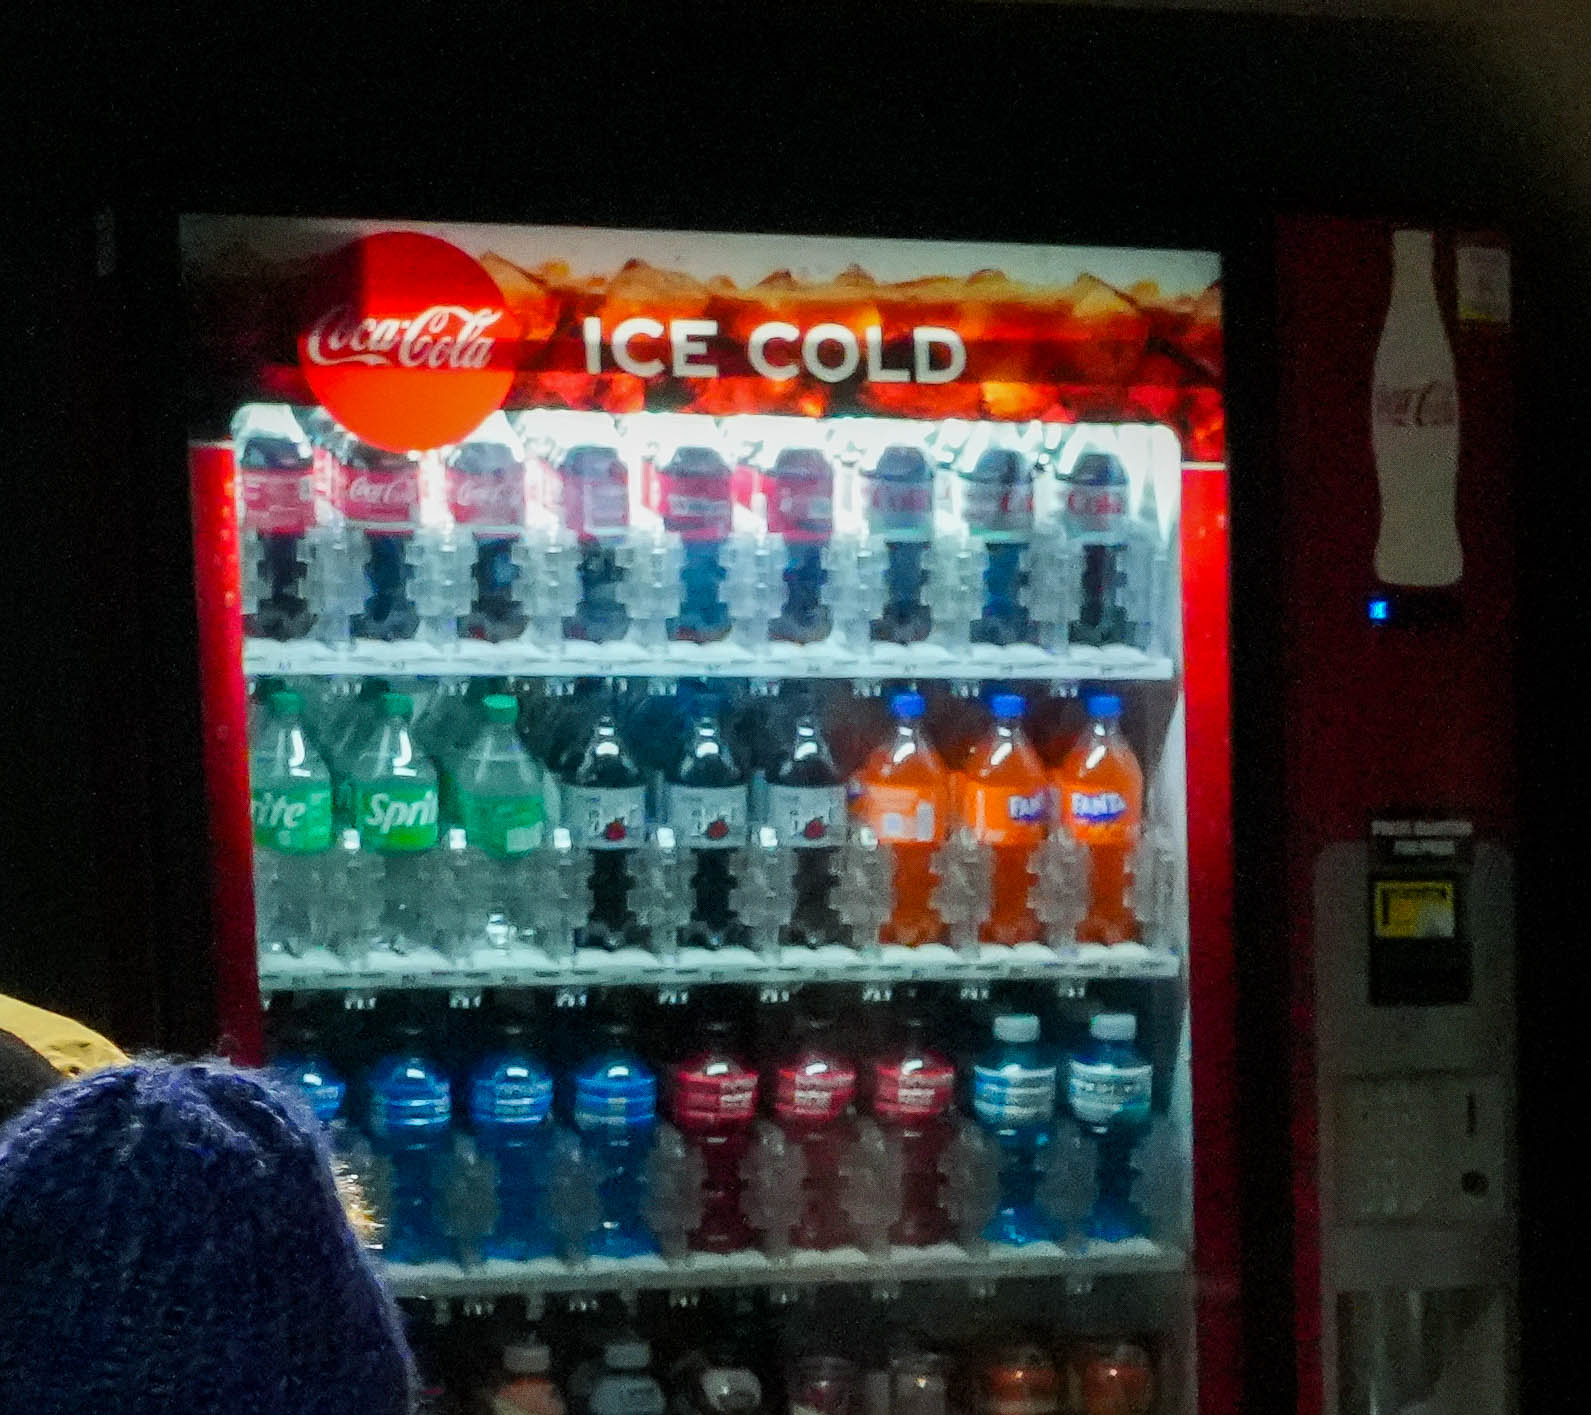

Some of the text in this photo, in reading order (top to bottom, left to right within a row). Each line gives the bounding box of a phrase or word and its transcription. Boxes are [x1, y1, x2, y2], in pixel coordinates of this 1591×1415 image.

[307, 304, 504, 369] Coca-Cola
[583, 315, 967, 385] ICE COLD
